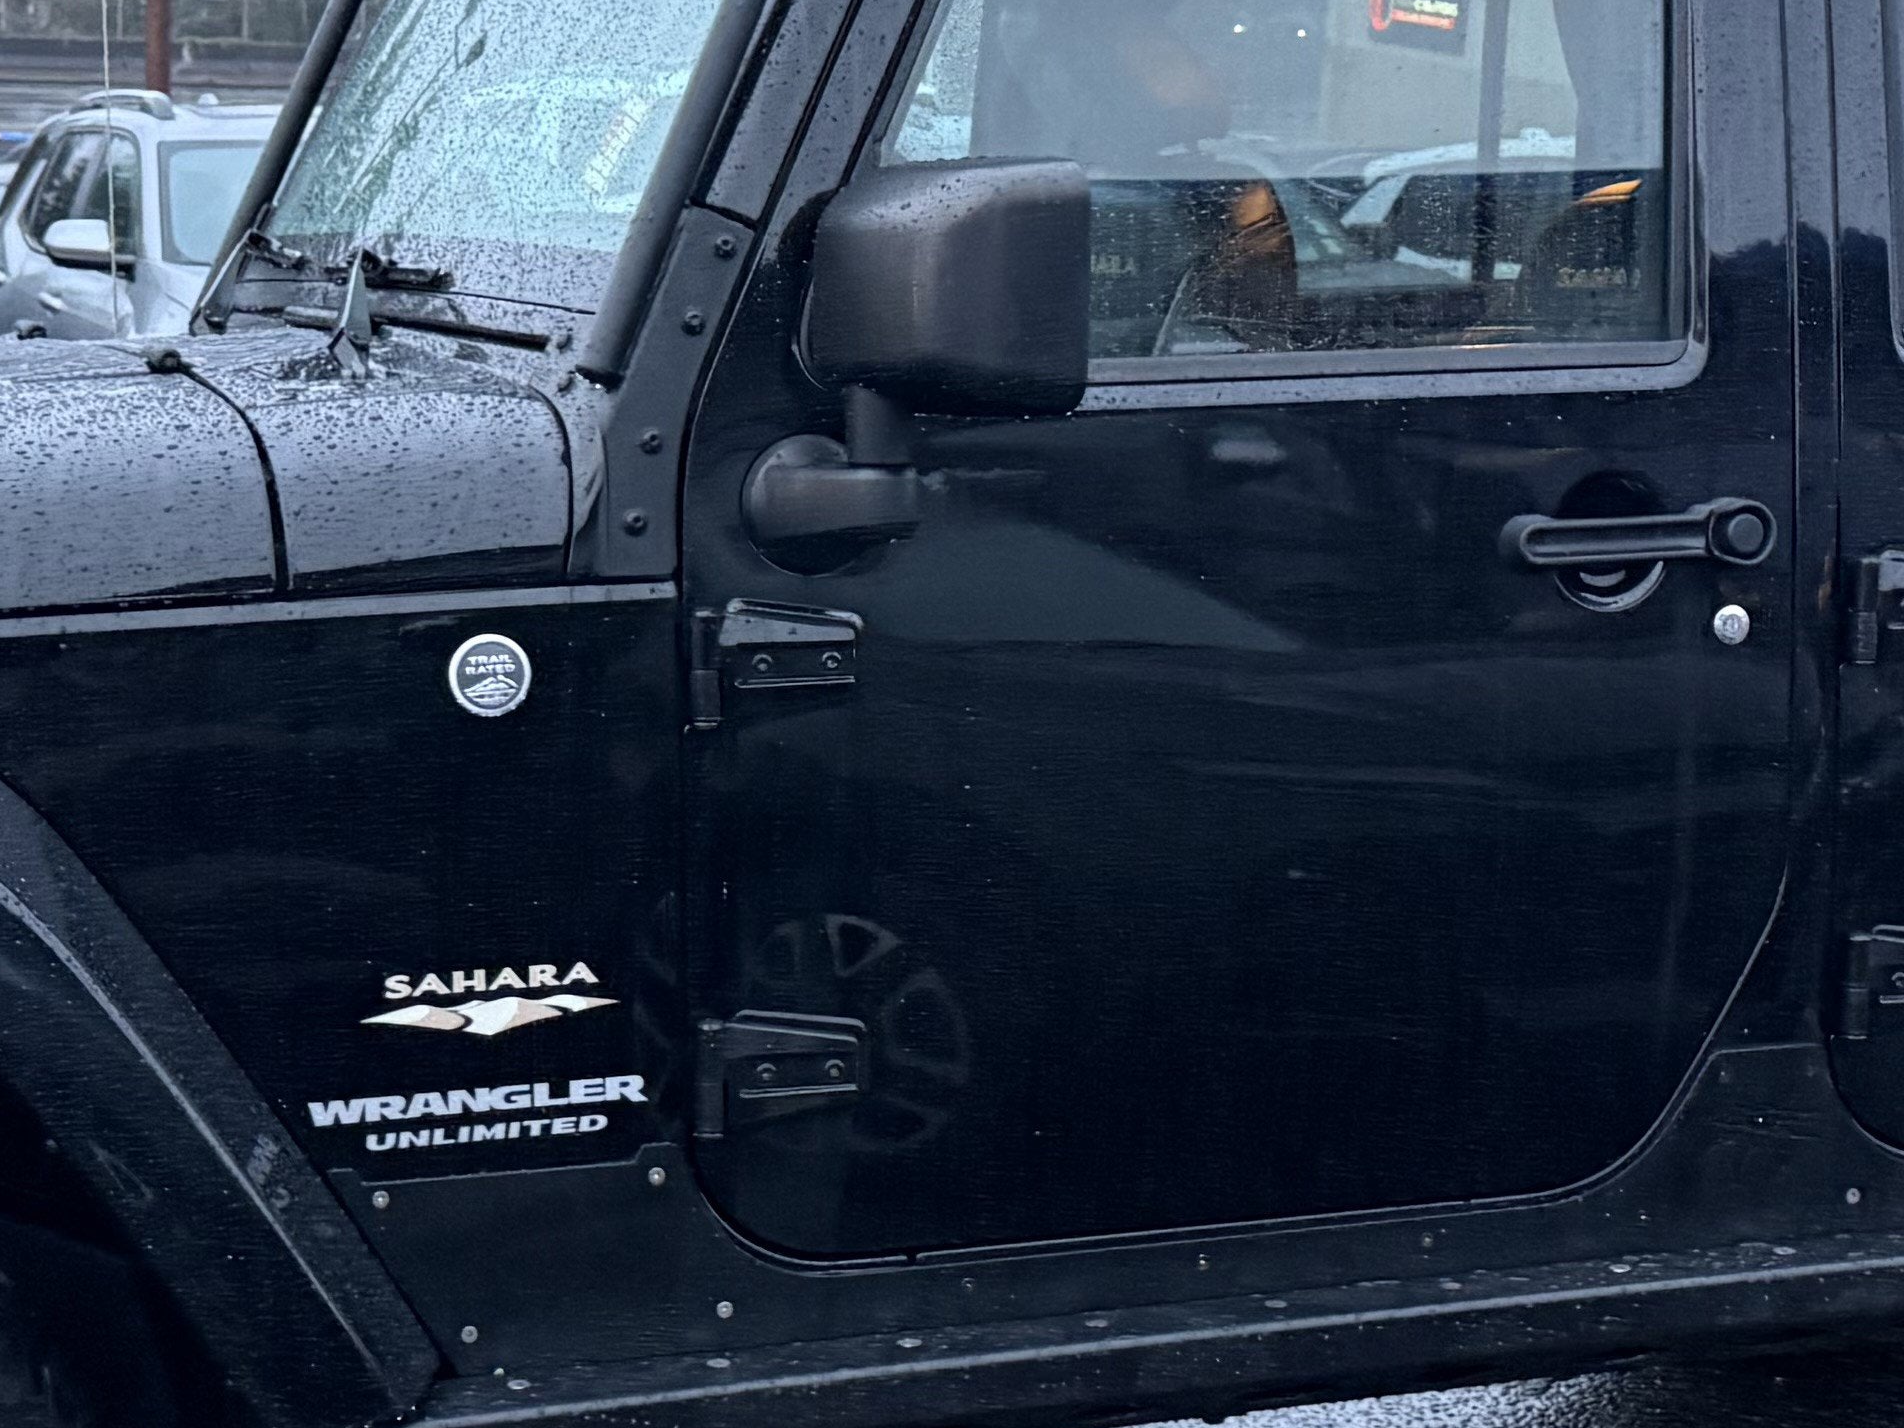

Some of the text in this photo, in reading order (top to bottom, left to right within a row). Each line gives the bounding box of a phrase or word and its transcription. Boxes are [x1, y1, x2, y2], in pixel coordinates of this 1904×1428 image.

[465, 664, 516, 675] RATED
[467, 654, 513, 664] TRAIL
[384, 962, 599, 999] SAHARA
[308, 1075, 648, 1126] WRANGLER
[366, 1114, 608, 1151] UNLIMITED
